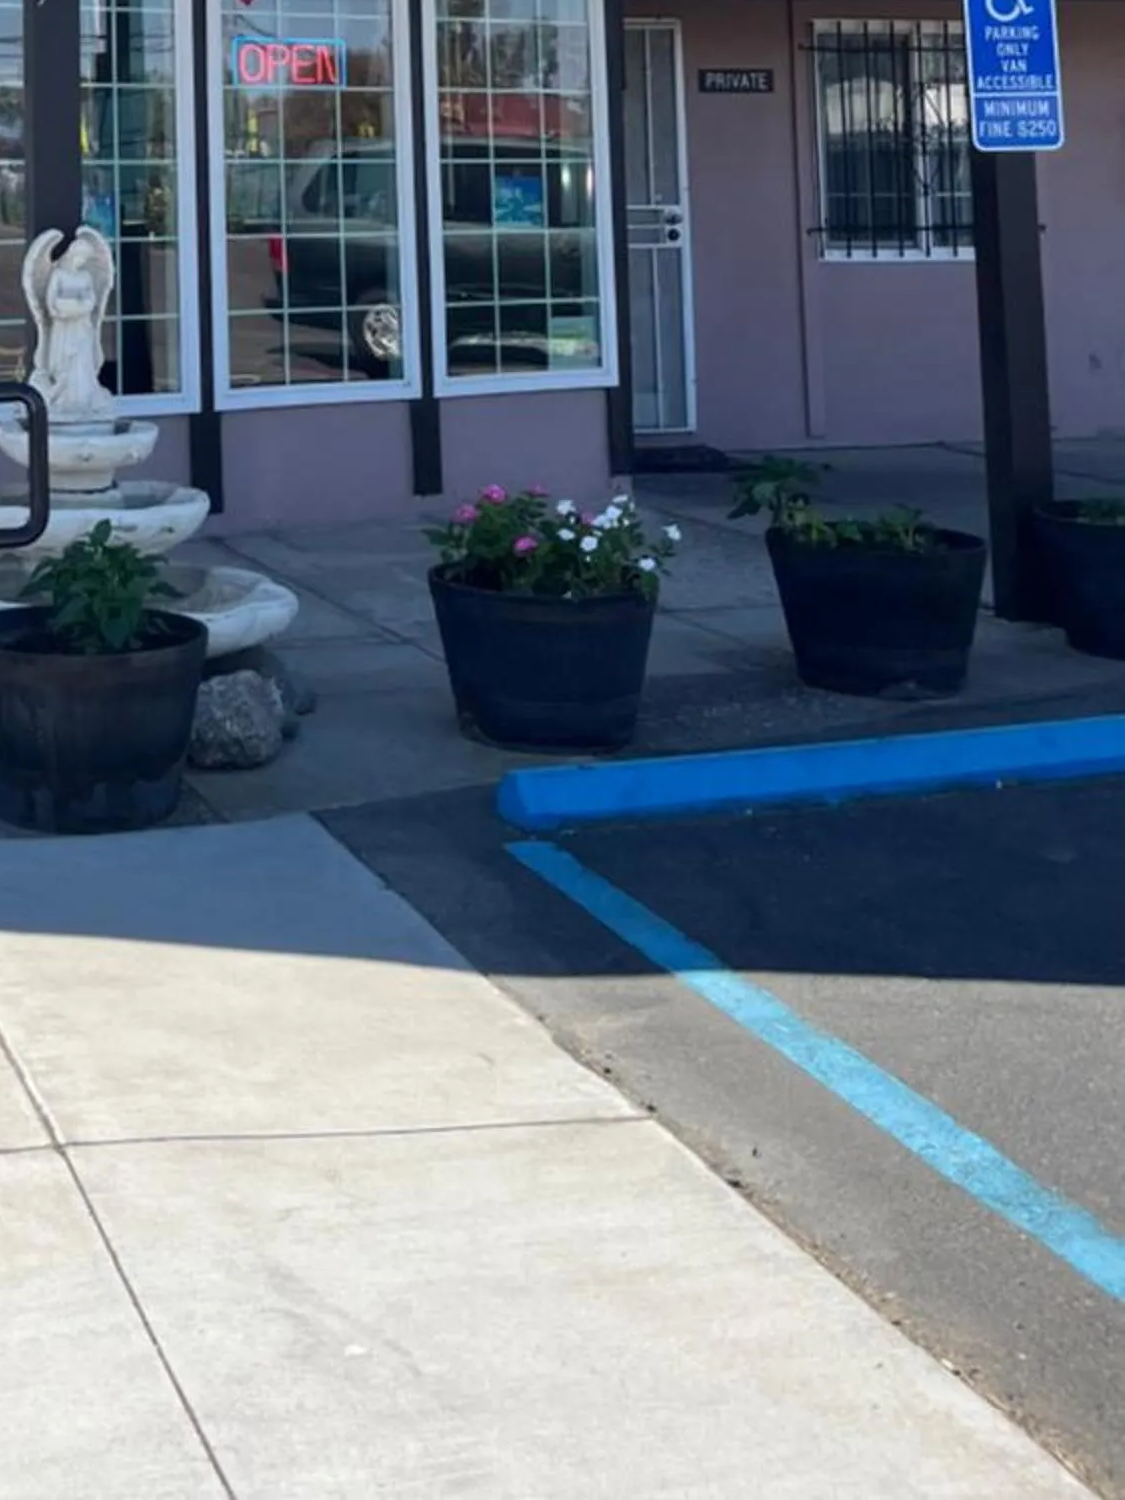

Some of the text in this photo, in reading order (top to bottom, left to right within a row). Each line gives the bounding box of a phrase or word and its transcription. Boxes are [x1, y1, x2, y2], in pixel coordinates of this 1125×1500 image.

[984, 25, 1040, 41] PARKING
[996, 42, 1029, 57] ONLY
[239, 43, 339, 84] OPEN
[1000, 59, 1028, 73] VAN
[704, 71, 769, 90] PRIVATE
[976, 74, 1053, 90] ACCESSIBLE
[983, 100, 1050, 117] MINIMUM
[979, 119, 1057, 138] FINE $250
